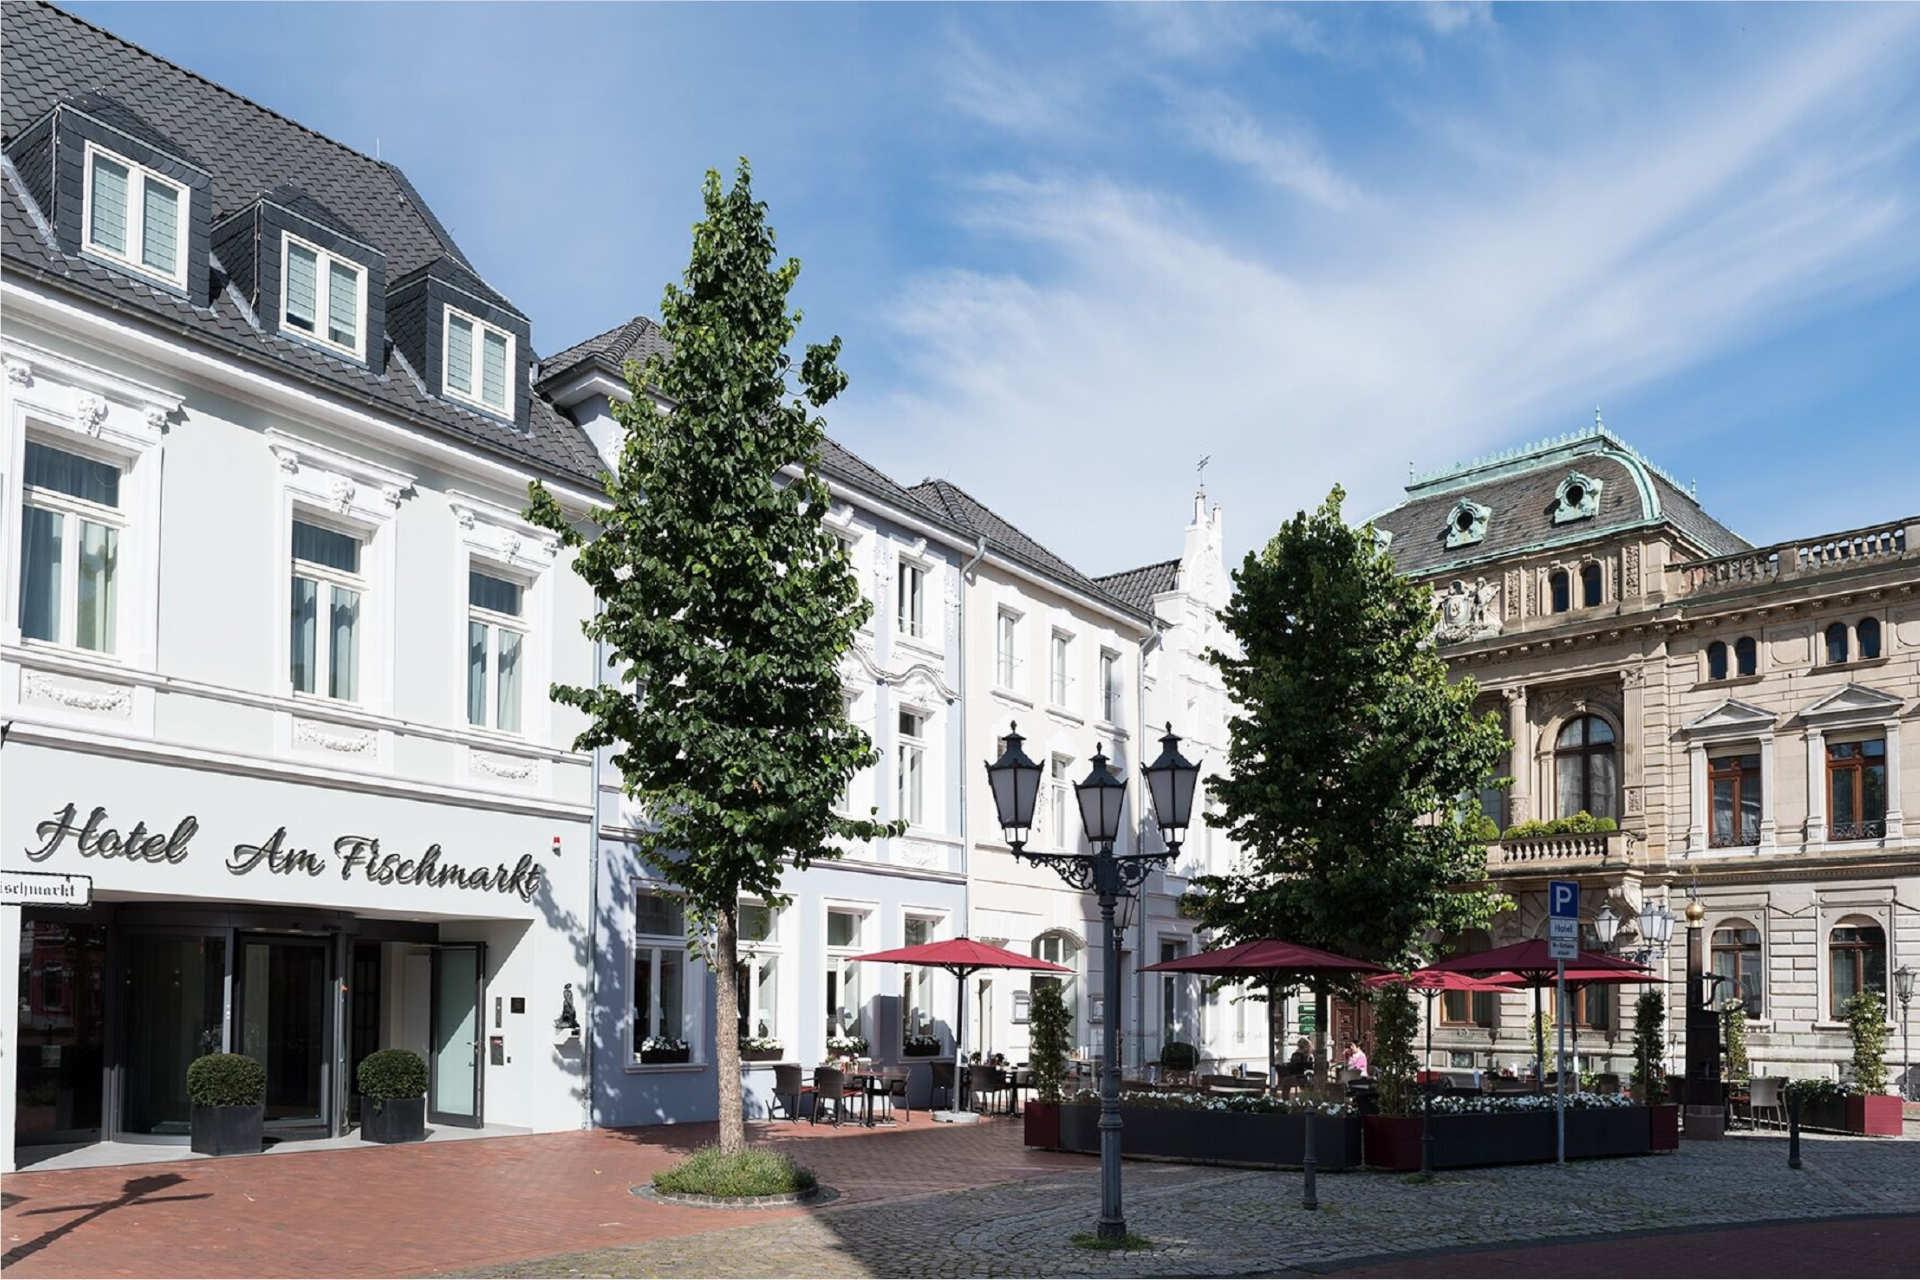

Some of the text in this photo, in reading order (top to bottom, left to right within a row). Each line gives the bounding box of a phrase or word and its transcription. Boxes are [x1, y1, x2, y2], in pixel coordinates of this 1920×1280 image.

[26, 803, 542, 903] Hotel Am Fischmarkt
[1556, 887, 1572, 913] P
